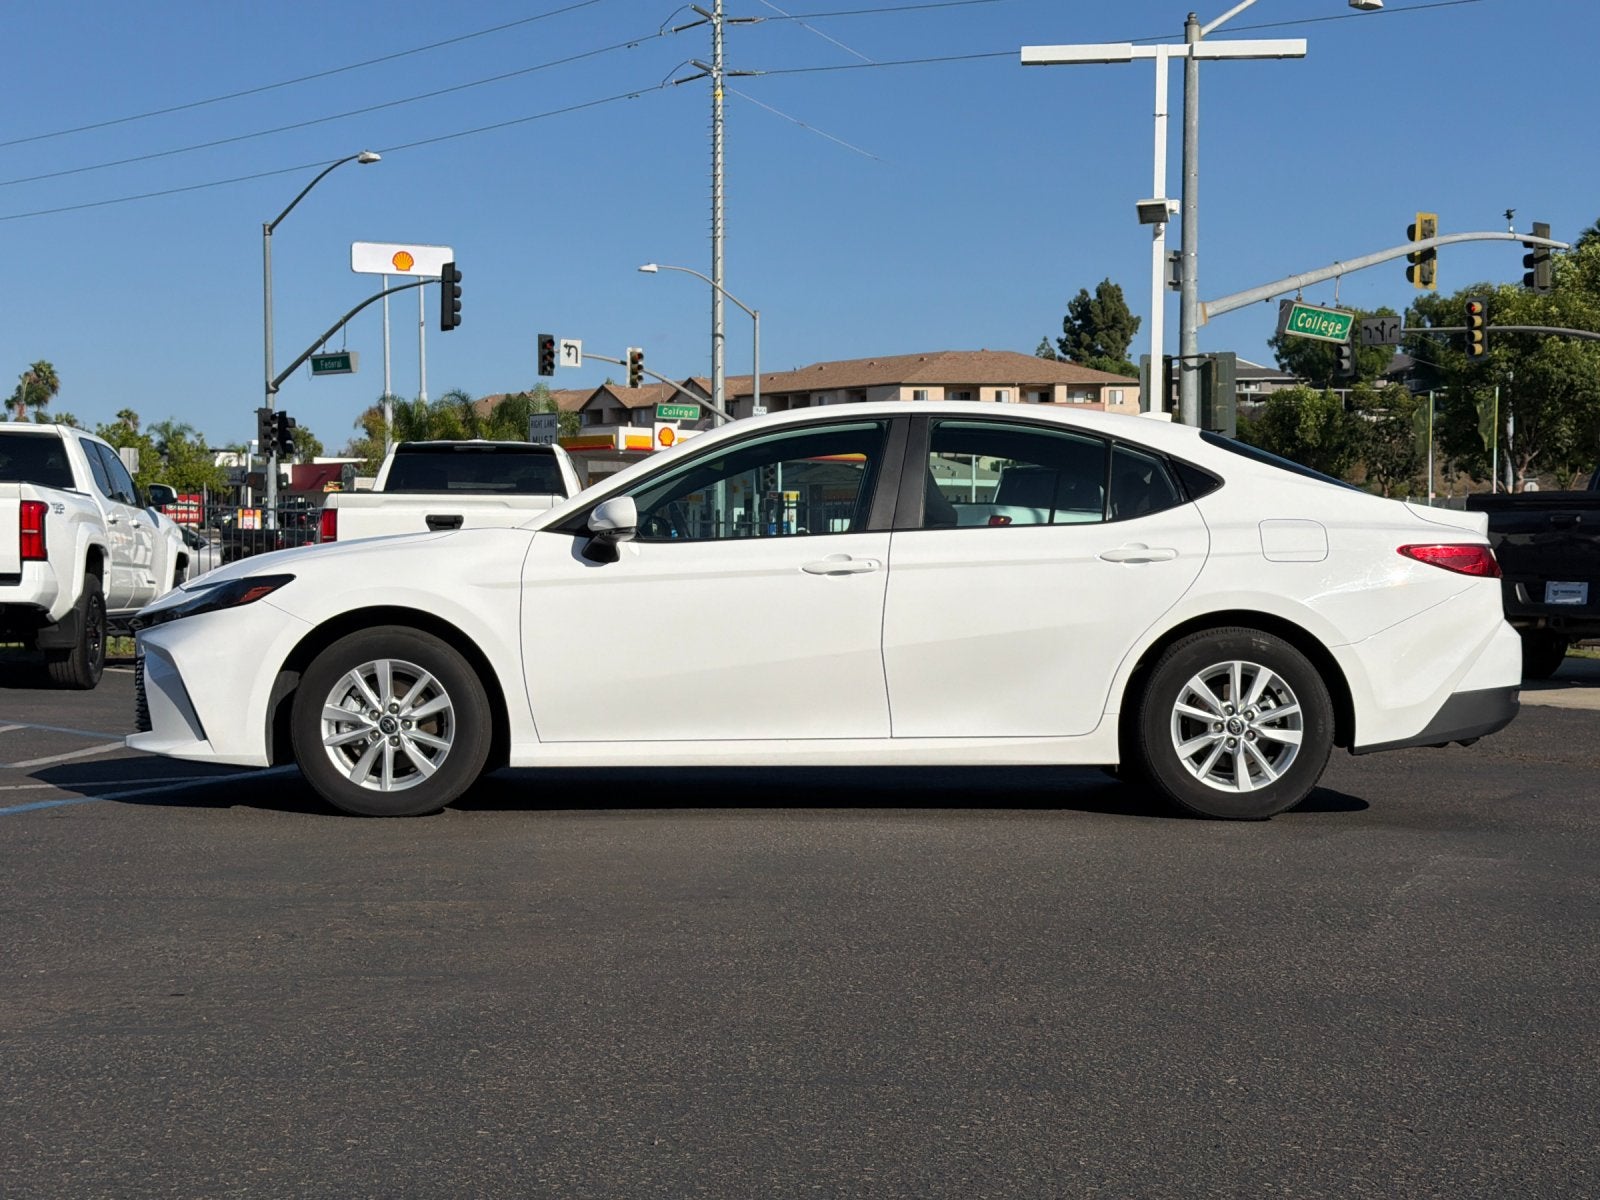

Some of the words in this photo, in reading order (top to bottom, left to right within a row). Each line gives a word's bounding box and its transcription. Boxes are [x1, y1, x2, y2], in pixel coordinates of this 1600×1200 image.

[1297, 312, 1342, 337] College
[662, 407, 694, 418] College
[532, 435, 553, 444] MUST
